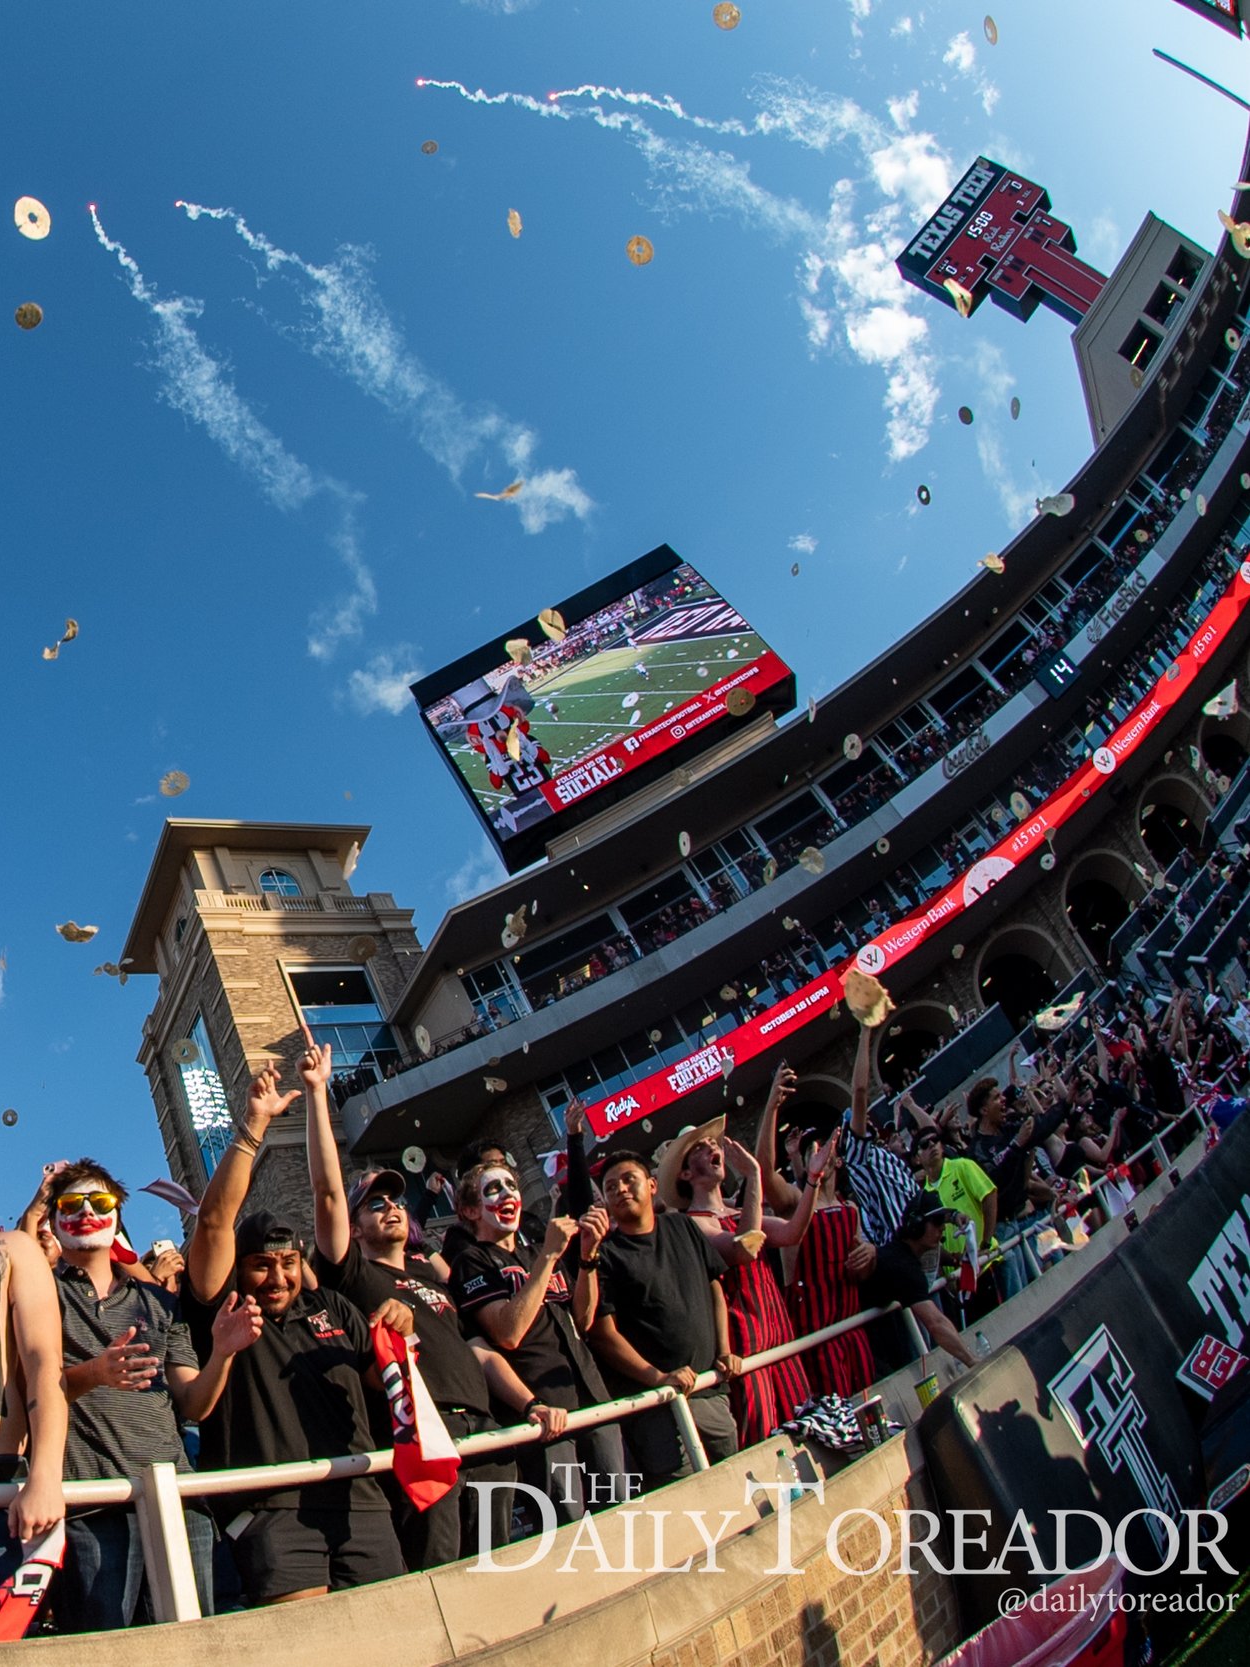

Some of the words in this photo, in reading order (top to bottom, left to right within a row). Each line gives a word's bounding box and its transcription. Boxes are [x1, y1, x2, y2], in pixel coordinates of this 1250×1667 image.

[909, 205, 965, 260] TEXAS
[951, 166, 995, 207] TECH
[967, 210, 994, 238] 15:00
[1050, 658, 1074, 685] 14
[1111, 716, 1143, 756] Western
[1140, 700, 1162, 726] Bank
[554, 755, 623, 805] SOCIAL!
[556, 764, 584, 787] FOLLOW
[584, 759, 596, 771] US
[595, 753, 608, 765] ON
[882, 917, 930, 956] Western
[926, 897, 957, 931] Bank
[759, 1007, 798, 1035] OCTOBER
[675, 1057, 692, 1073] RED
[691, 1044, 719, 1065] RAIDER
[604, 1094, 641, 1124] Rudy's
